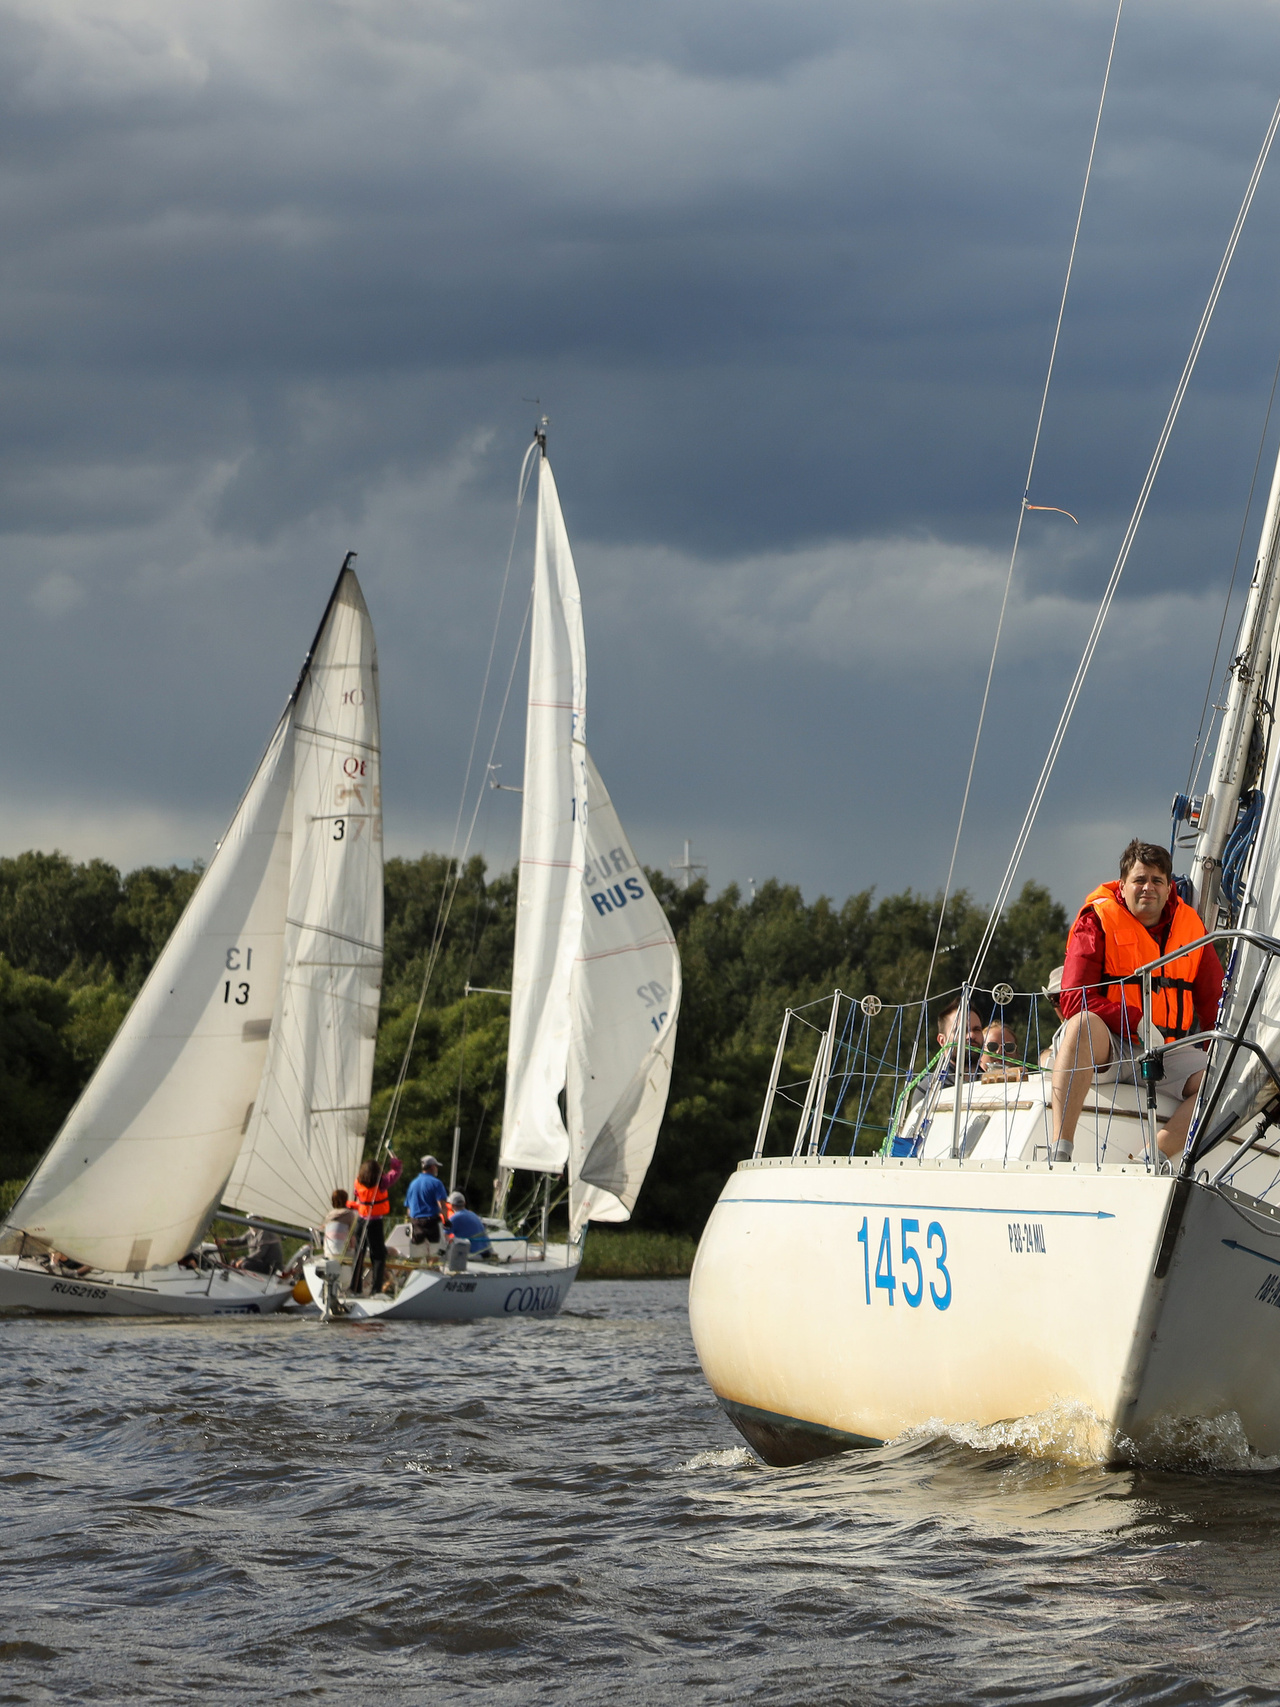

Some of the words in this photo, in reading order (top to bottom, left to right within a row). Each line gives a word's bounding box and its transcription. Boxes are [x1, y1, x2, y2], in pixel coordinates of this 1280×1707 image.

[342, 756, 368, 779] Qt
[590, 877, 645, 917] RUS
[224, 980, 250, 1006] 13
[857, 1216, 951, 1311] 1453
